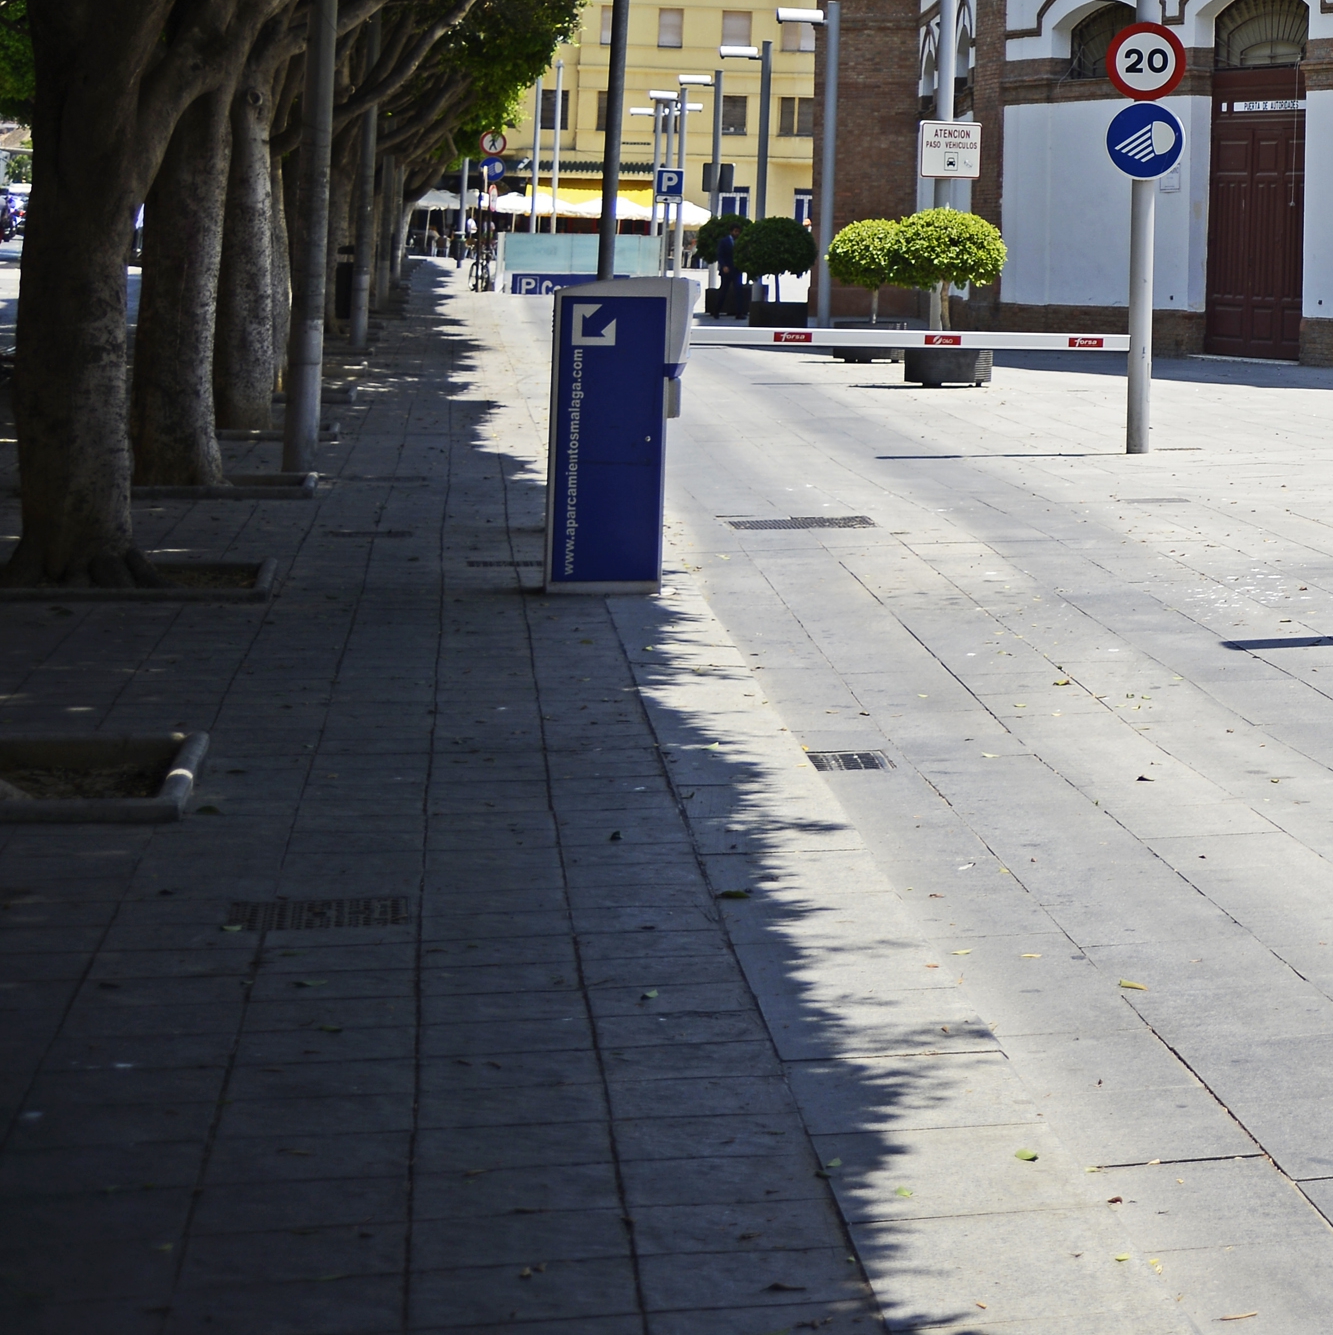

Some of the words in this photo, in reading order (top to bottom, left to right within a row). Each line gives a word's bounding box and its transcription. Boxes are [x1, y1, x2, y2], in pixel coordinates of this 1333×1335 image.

[1124, 48, 1169, 74] 20
[933, 128, 971, 139] ATENCION
[944, 141, 978, 150] VEHICULOS
[661, 172, 679, 192] P
[521, 278, 536, 295] P
[780, 331, 806, 342] forsa
[1074, 337, 1098, 348] forsa
[564, 348, 584, 576] www.aparcamientosmalaga.com
